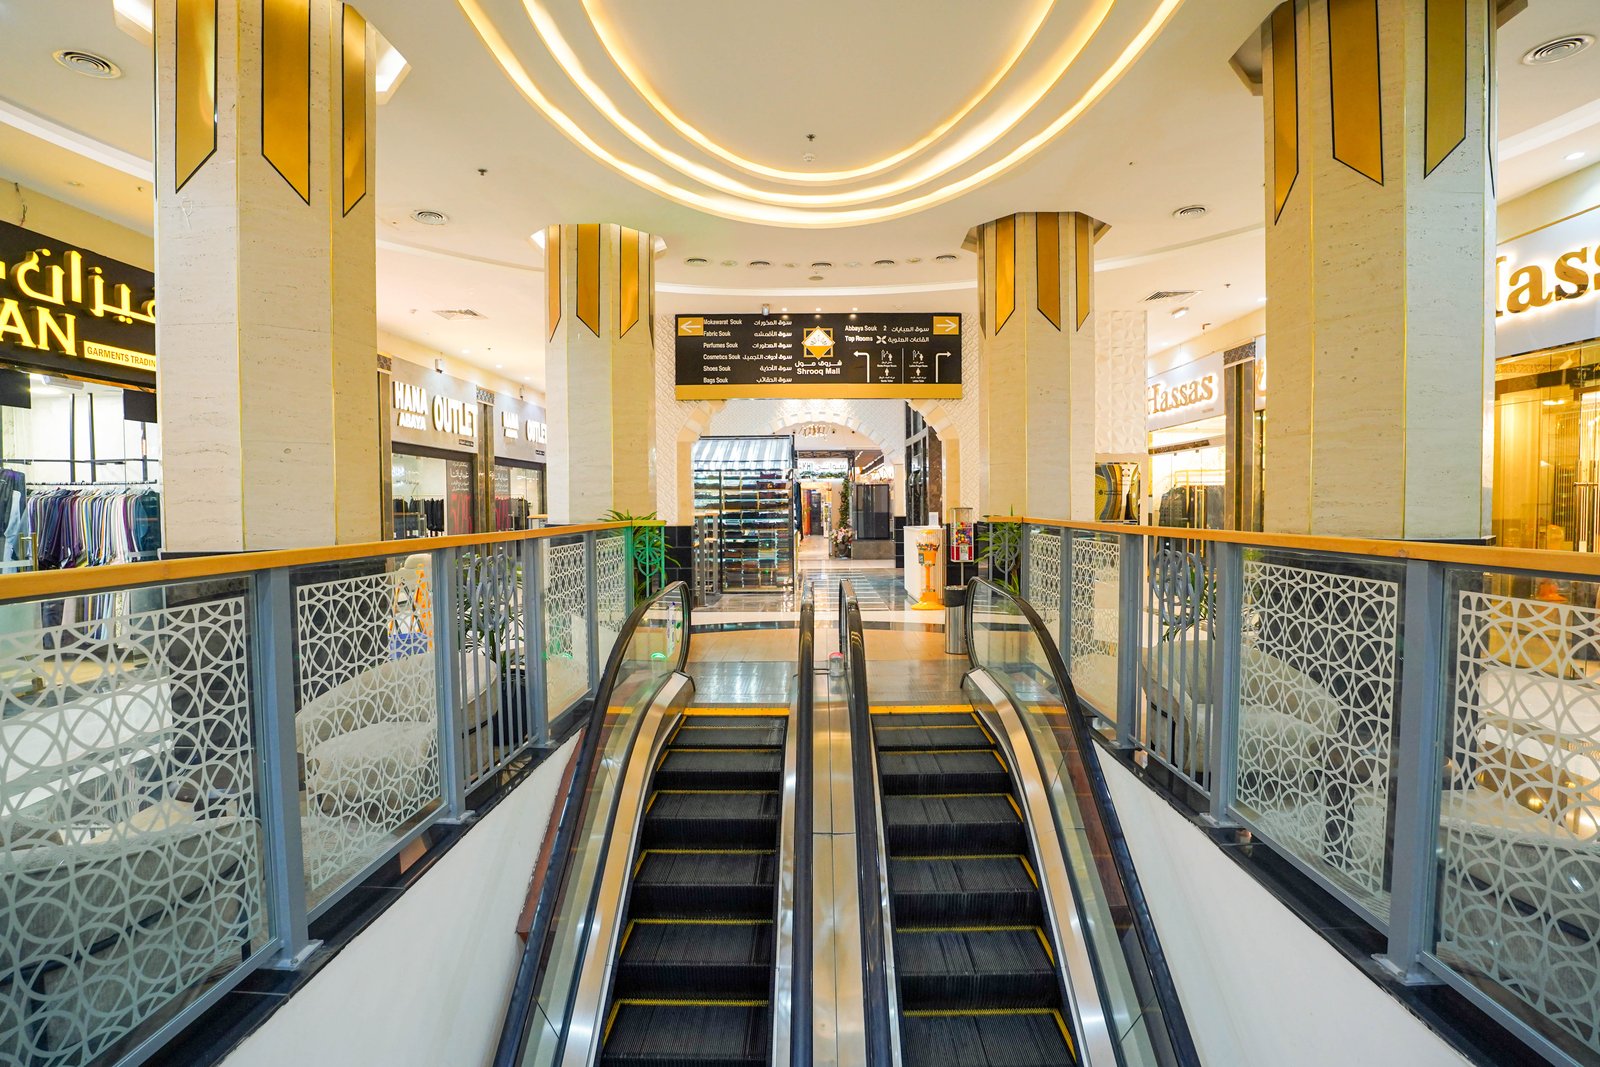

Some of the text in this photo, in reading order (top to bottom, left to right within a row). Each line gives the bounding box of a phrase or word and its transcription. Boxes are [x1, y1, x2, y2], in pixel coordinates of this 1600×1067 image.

[1496, 245, 1600, 317] as
[845, 325, 864, 333] Abbaya
[845, 335, 855, 343] Top
[86, 346, 155, 368] GARMENTS TRADIN
[796, 367, 841, 376] Shrooq Mall
[393, 381, 428, 415] HANA
[1148, 375, 1214, 414] Hassas
[397, 411, 427, 431] ABAYA
[432, 394, 478, 438] OUTLET
